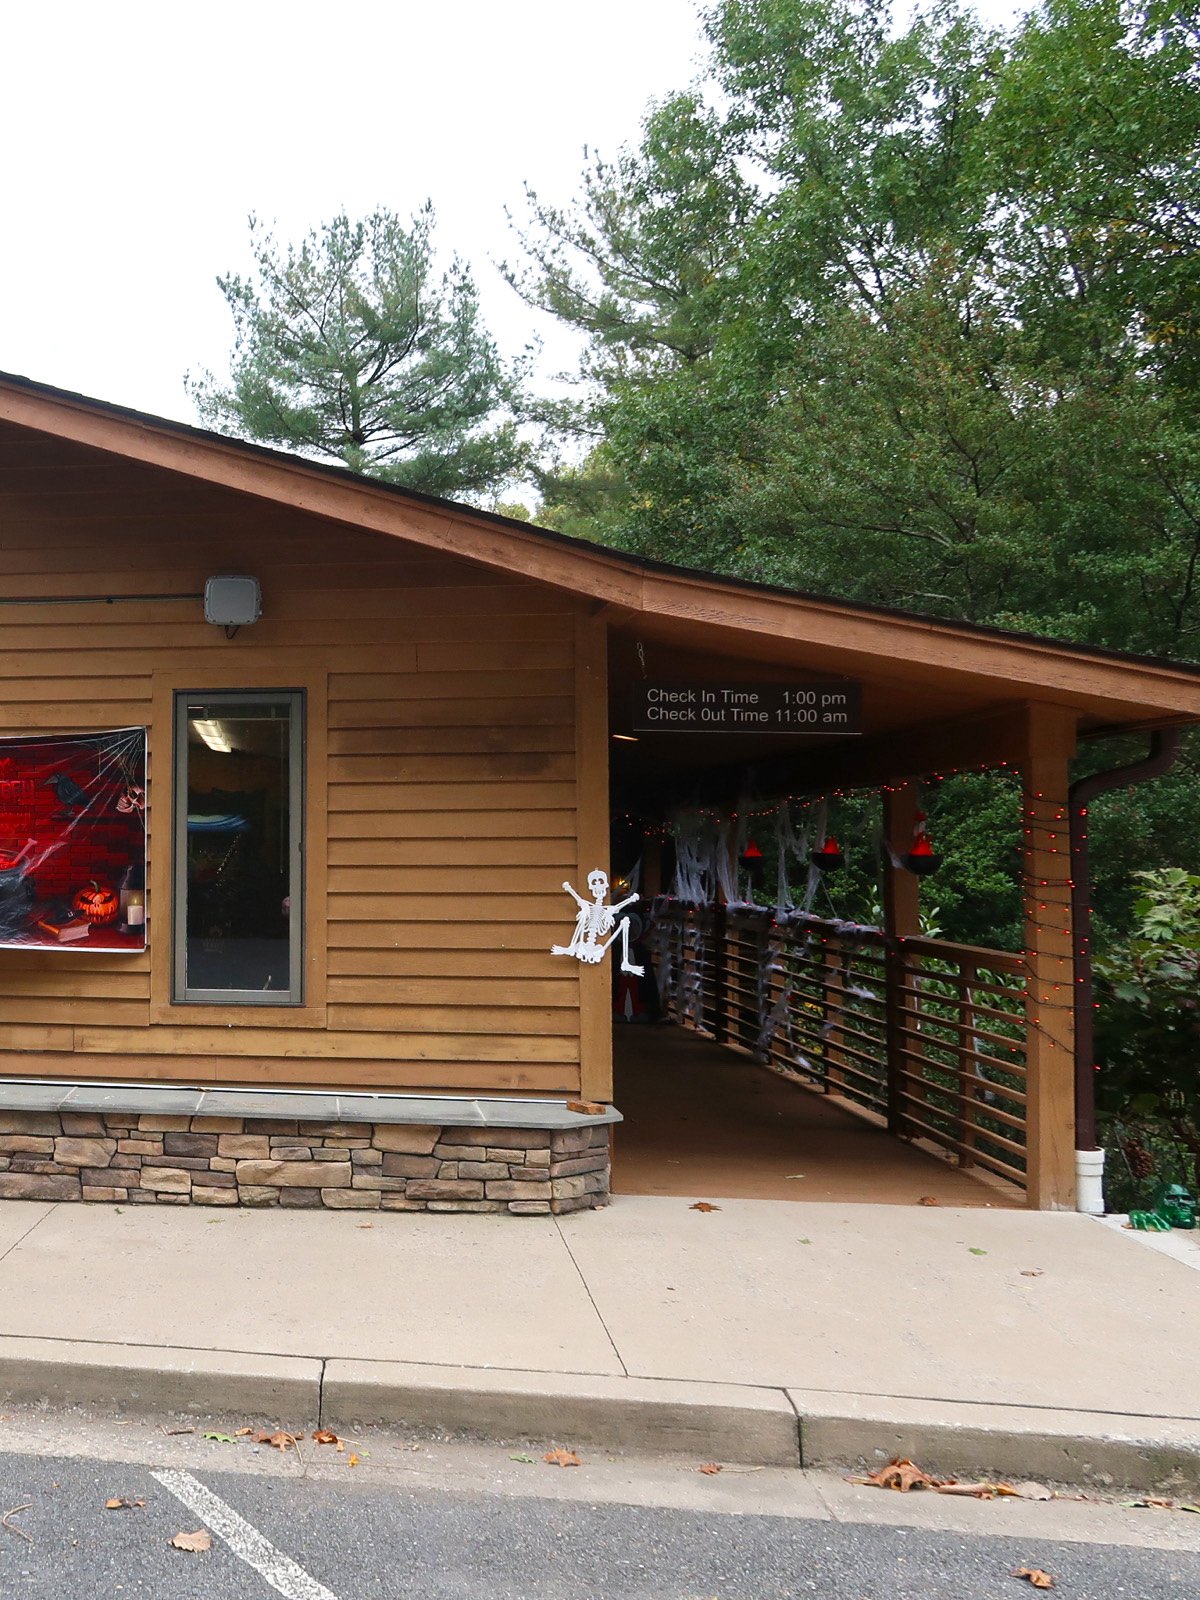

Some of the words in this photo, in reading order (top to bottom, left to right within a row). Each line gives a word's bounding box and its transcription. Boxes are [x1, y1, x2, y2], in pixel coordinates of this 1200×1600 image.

[647, 688, 696, 703] Check
[702, 689, 716, 703] In
[721, 689, 759, 704] Time
[783, 691, 816, 705] 1:00
[821, 694, 846, 708] pm
[647, 706, 696, 721] Check
[730, 708, 769, 722] Time
[775, 709, 817, 723] 11:00
[822, 711, 847, 723] am
